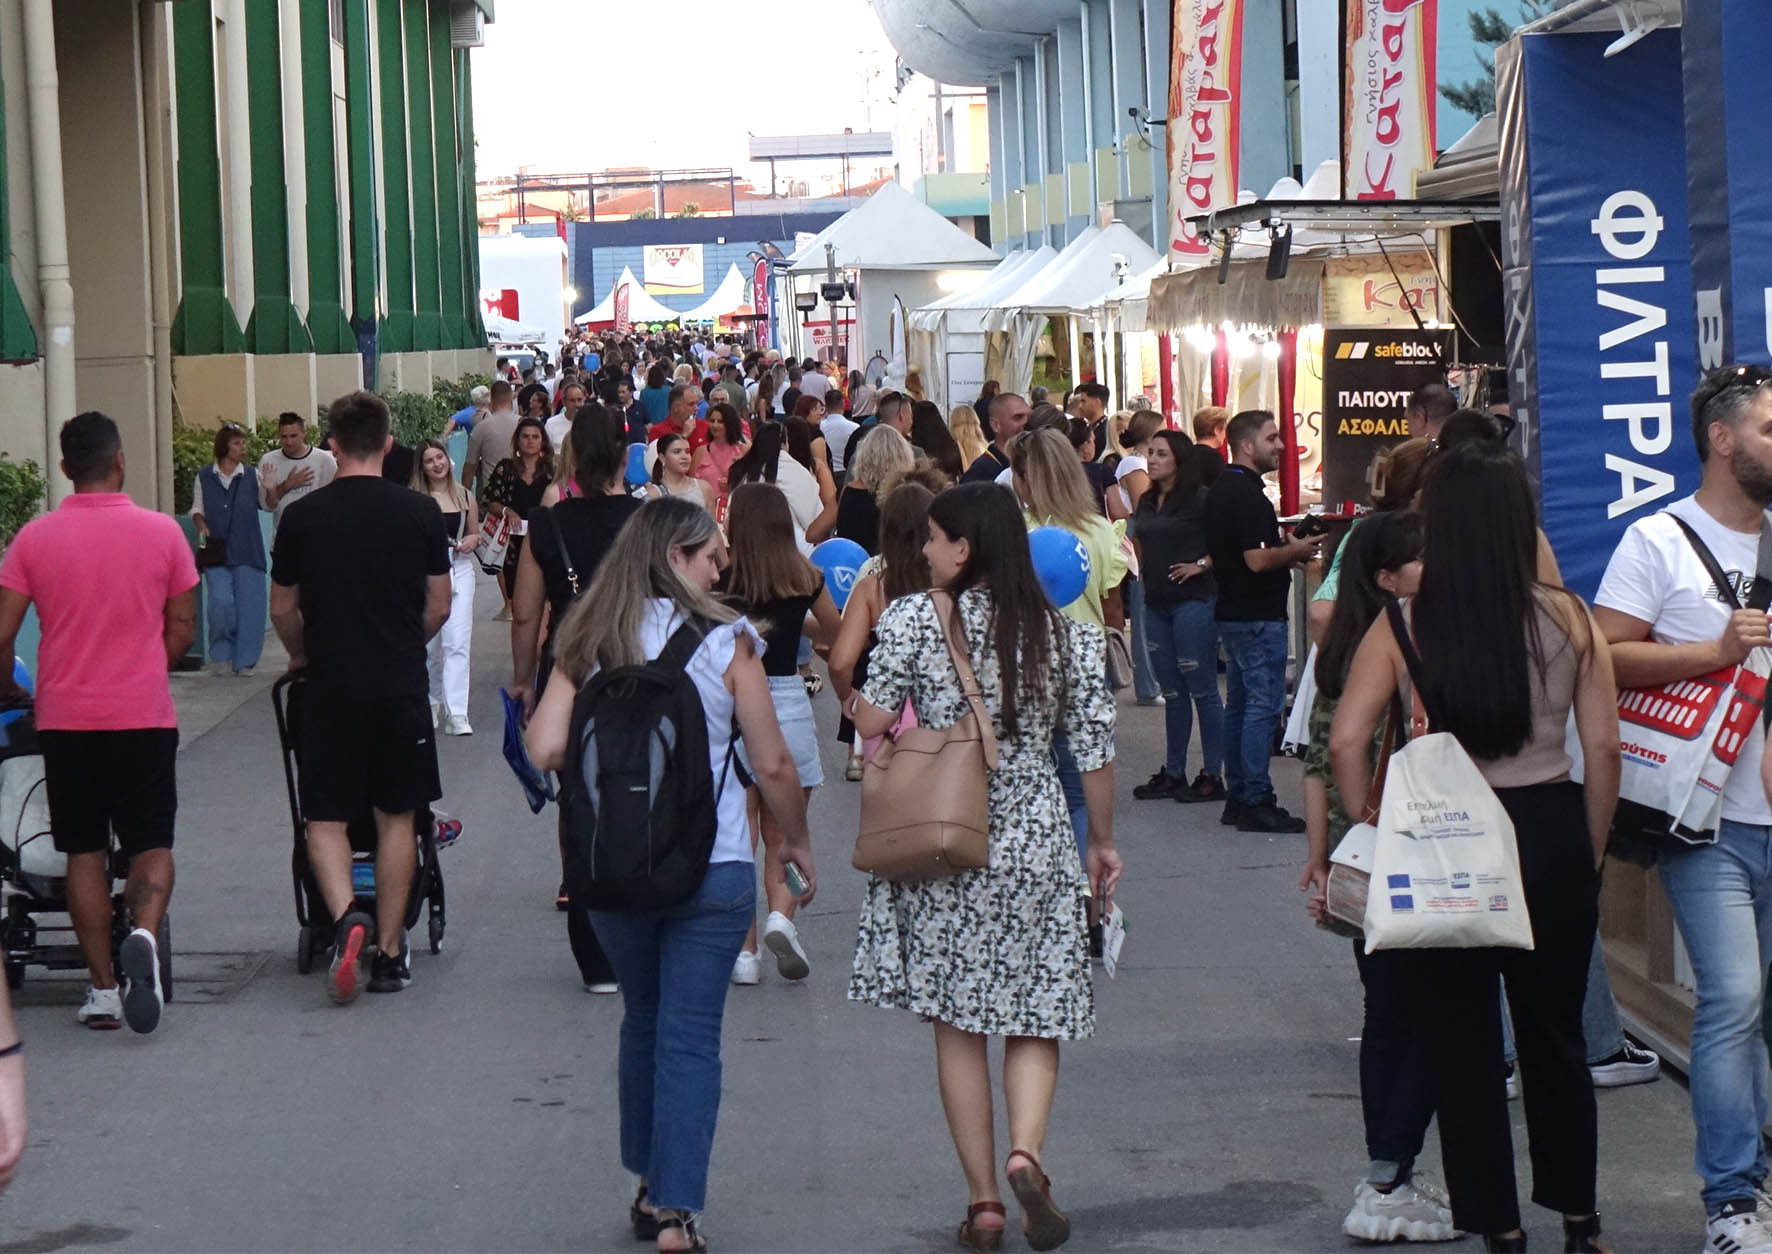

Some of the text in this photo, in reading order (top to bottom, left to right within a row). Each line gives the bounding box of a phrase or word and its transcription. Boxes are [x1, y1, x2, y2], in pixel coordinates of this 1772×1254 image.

[1364, 50, 1380, 124] Γνήσιος
[1591, 190, 1675, 519] ΦΙΛΤΡΑ
[1338, 391, 1414, 408] ΠΑΠΟΥΤ
